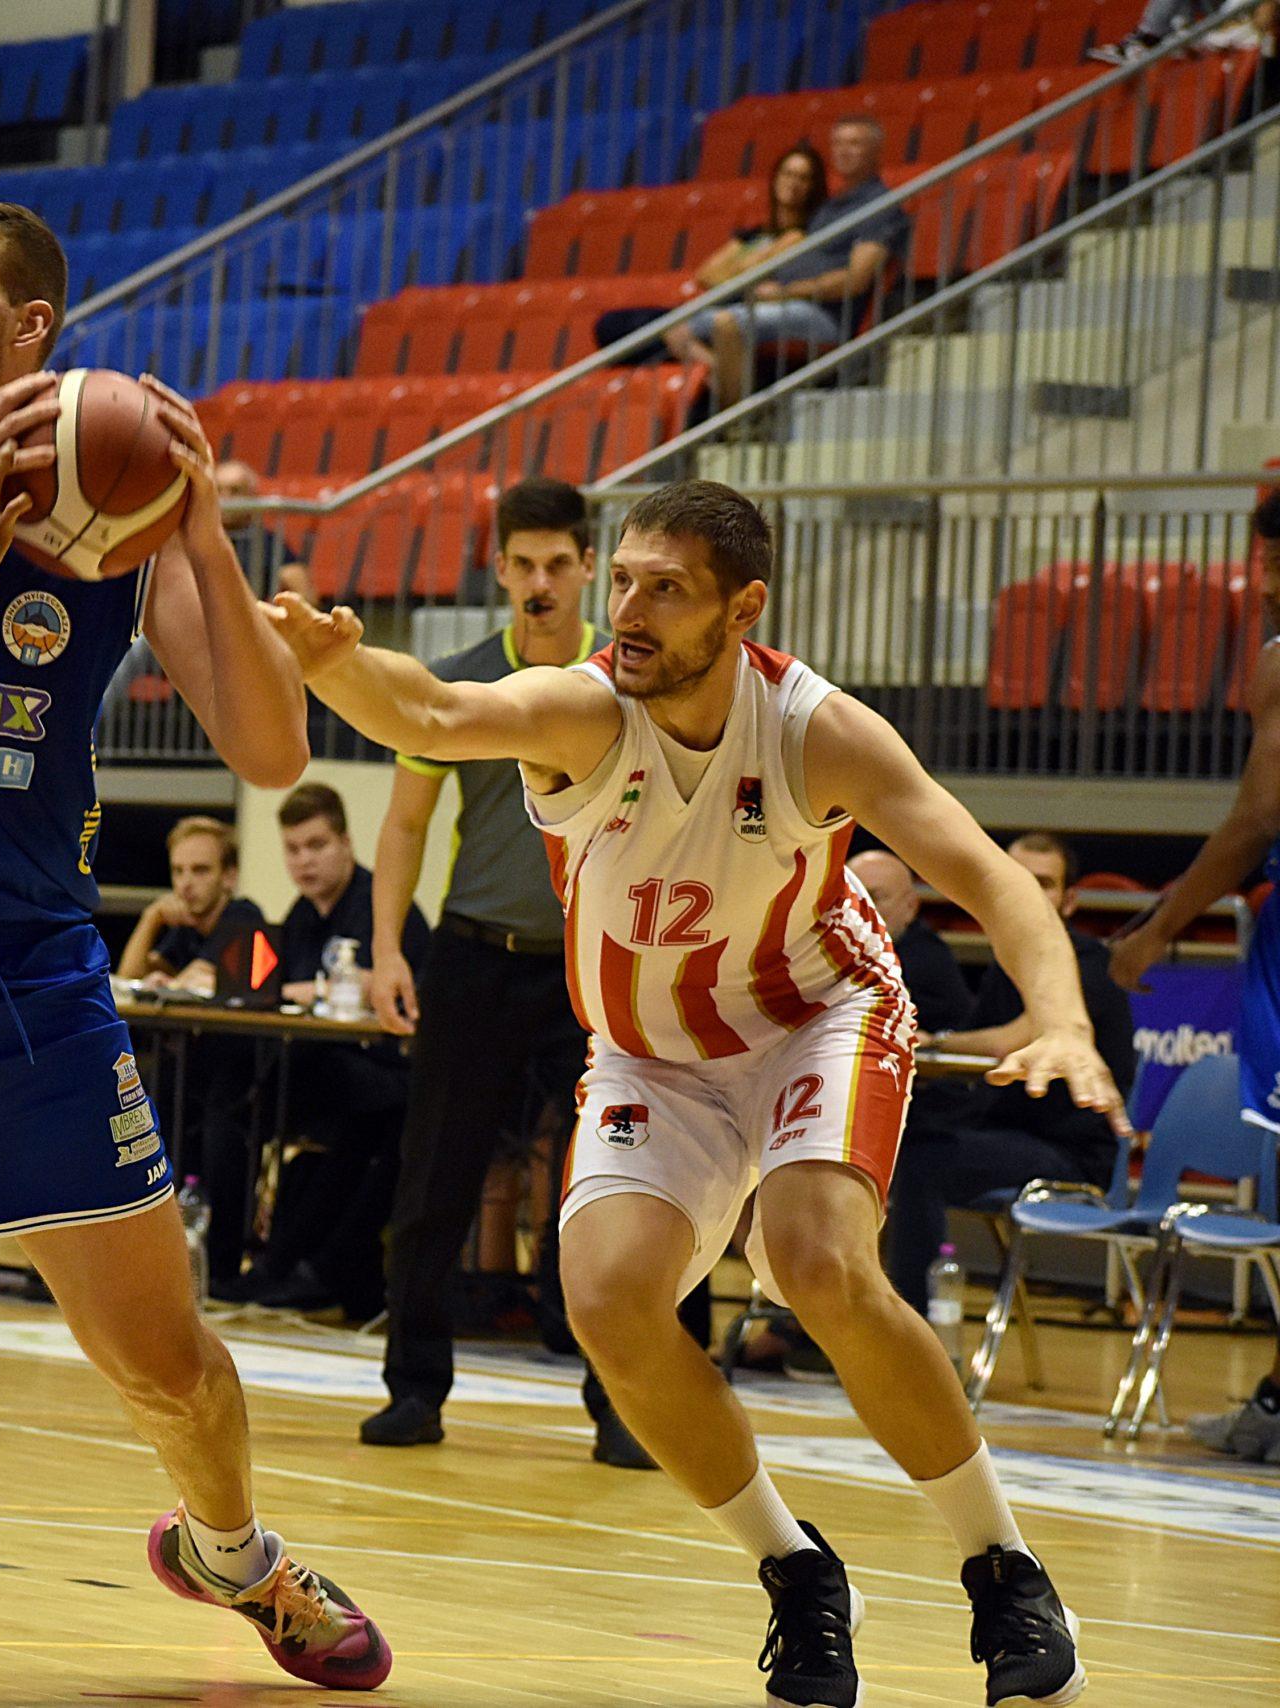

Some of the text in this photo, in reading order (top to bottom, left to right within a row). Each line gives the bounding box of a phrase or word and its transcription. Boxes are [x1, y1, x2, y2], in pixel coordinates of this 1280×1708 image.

[628, 877, 714, 947] 12
[1133, 1022, 1233, 1066] molten
[772, 1073, 824, 1136] 12
[608, 1134, 634, 1147] HONVÉD
[147, 1156, 168, 1185] JAK
